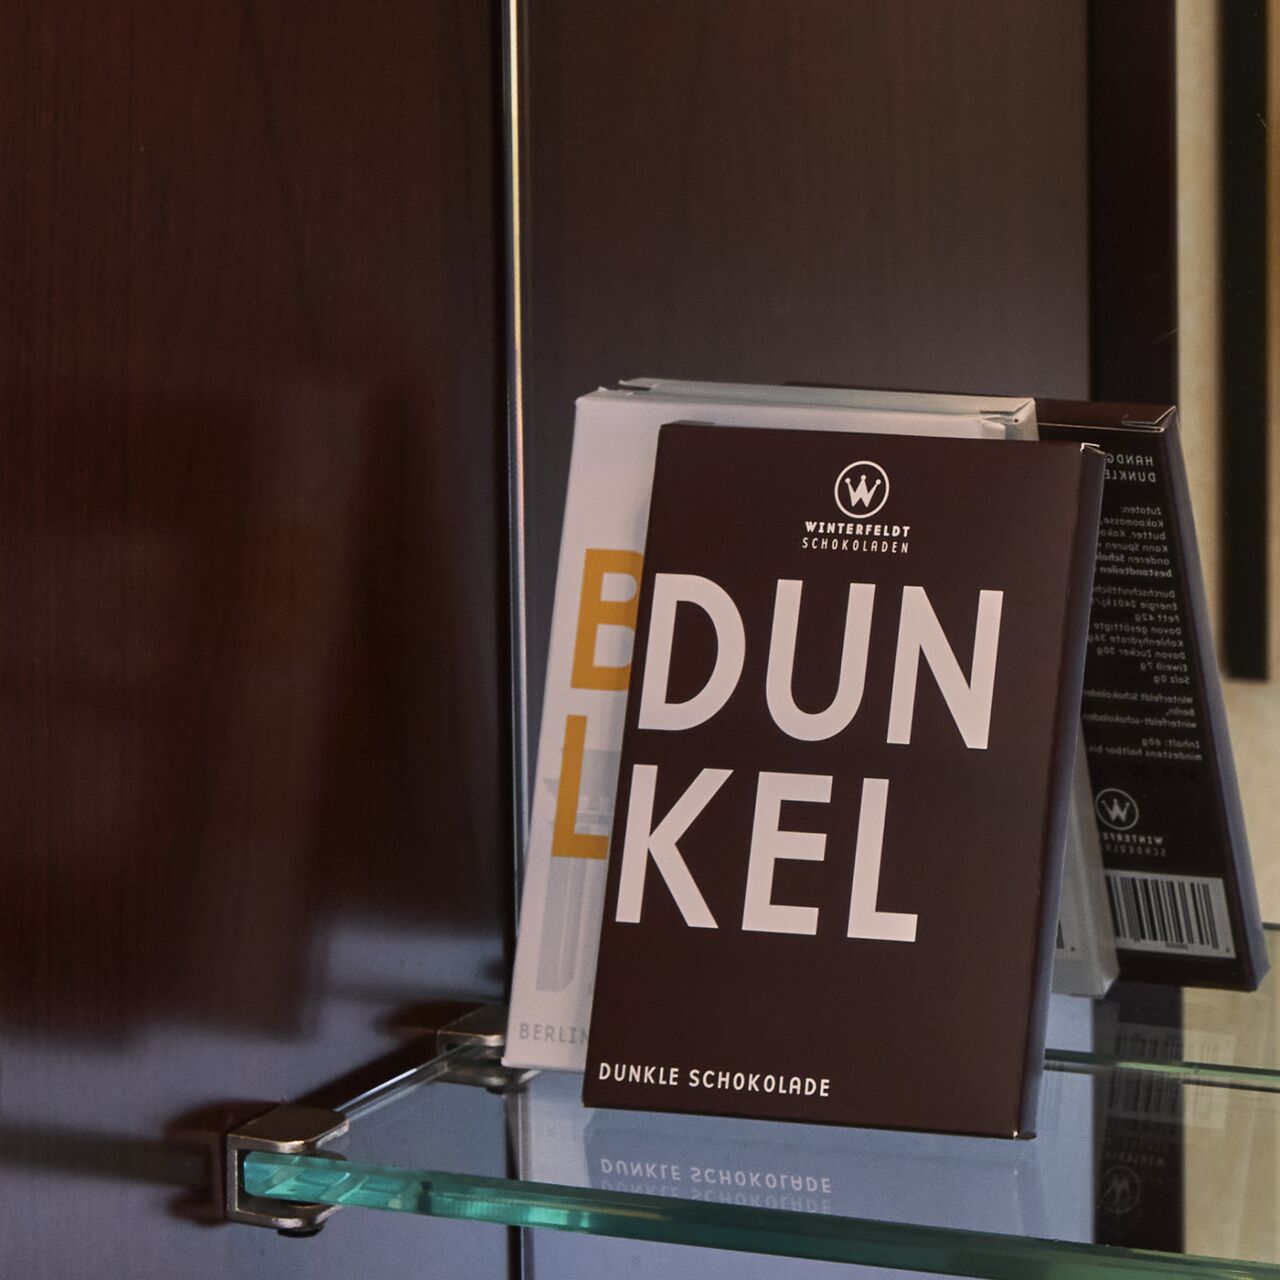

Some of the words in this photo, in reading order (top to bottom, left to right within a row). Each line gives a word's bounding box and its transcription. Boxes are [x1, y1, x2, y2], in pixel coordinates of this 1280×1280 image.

[802, 537, 909, 554] SCHOKOLADEN
[805, 520, 911, 538] WINTERFELDT
[637, 571, 1004, 751] DUN
[615, 763, 918, 943] KEL
[598, 1061, 680, 1087] DUNKLE
[688, 1068, 832, 1097] SCHOKOLADE
